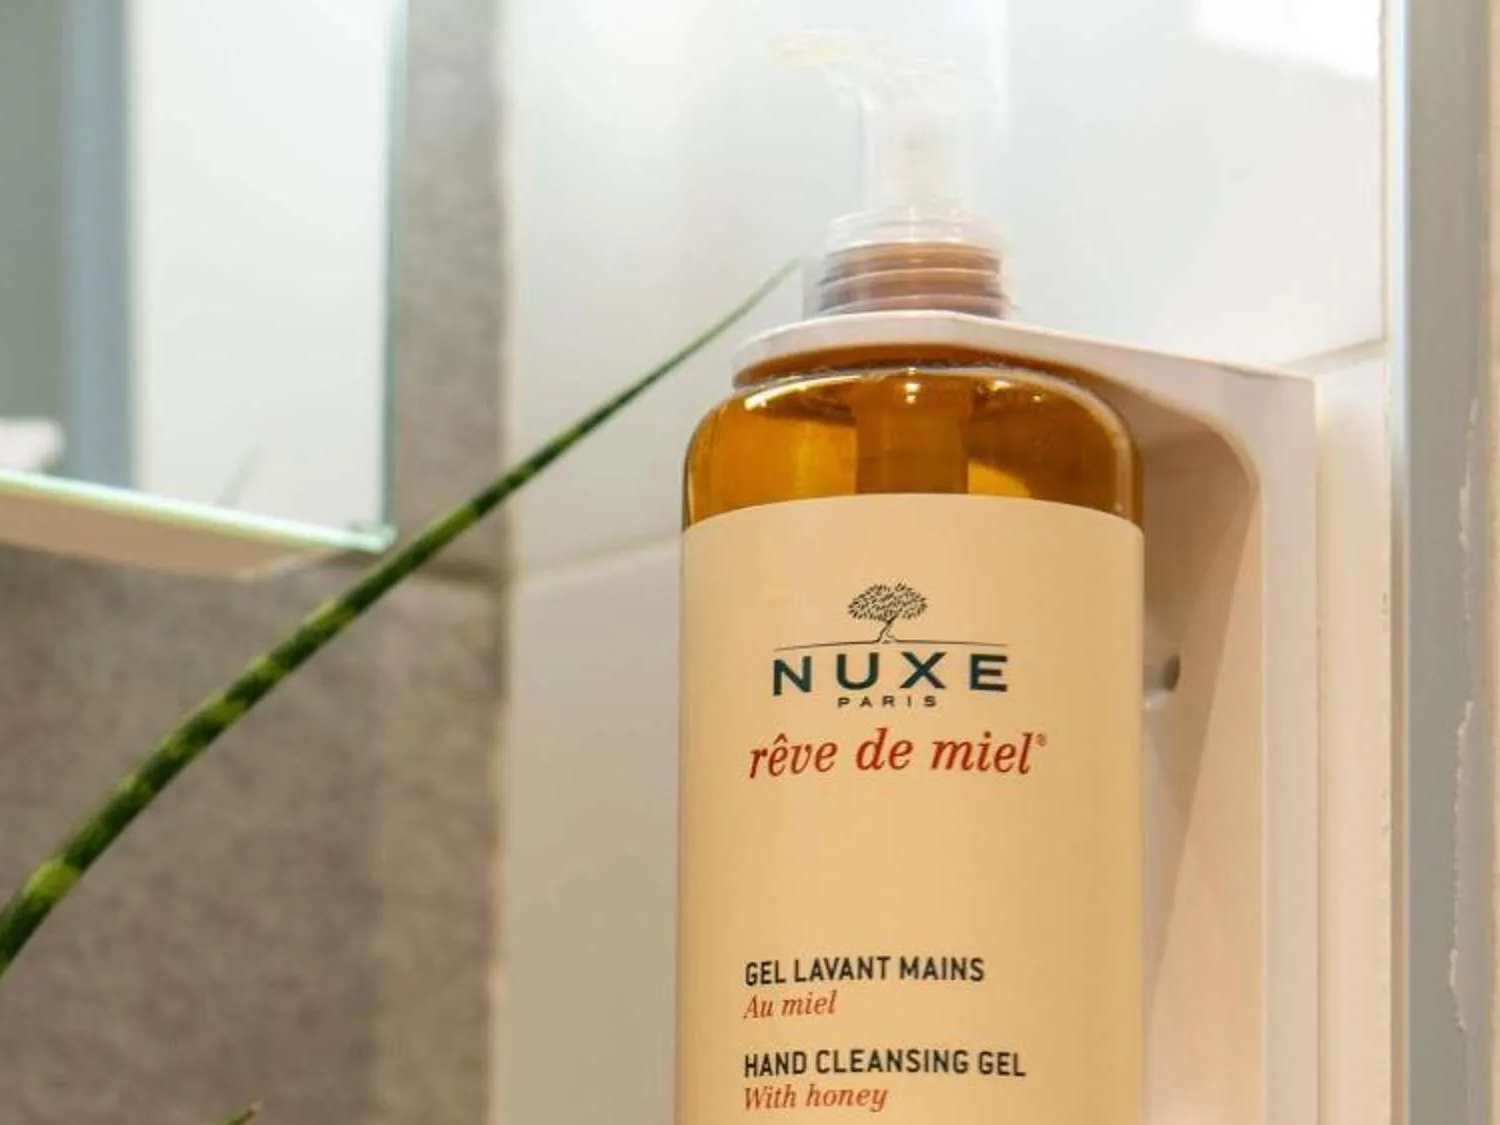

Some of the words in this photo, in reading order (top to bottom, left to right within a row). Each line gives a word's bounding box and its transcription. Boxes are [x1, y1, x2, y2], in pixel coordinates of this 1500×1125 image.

[772, 652, 1008, 696] NUXE
[838, 696, 936, 708] PARIS
[750, 733, 838, 779] rêve
[856, 728, 913, 770] de
[746, 960, 786, 986] GEL
[794, 956, 890, 982] LAVANT
[900, 957, 984, 982] MAINS
[744, 995, 773, 1019] Au
[782, 989, 837, 1016] miel
[745, 1051, 806, 1078] HAND
[816, 1049, 969, 1074] CLEANSING
[978, 1051, 1026, 1077] GEL
[745, 1084, 796, 1110] With
[806, 1083, 888, 1112] honey
